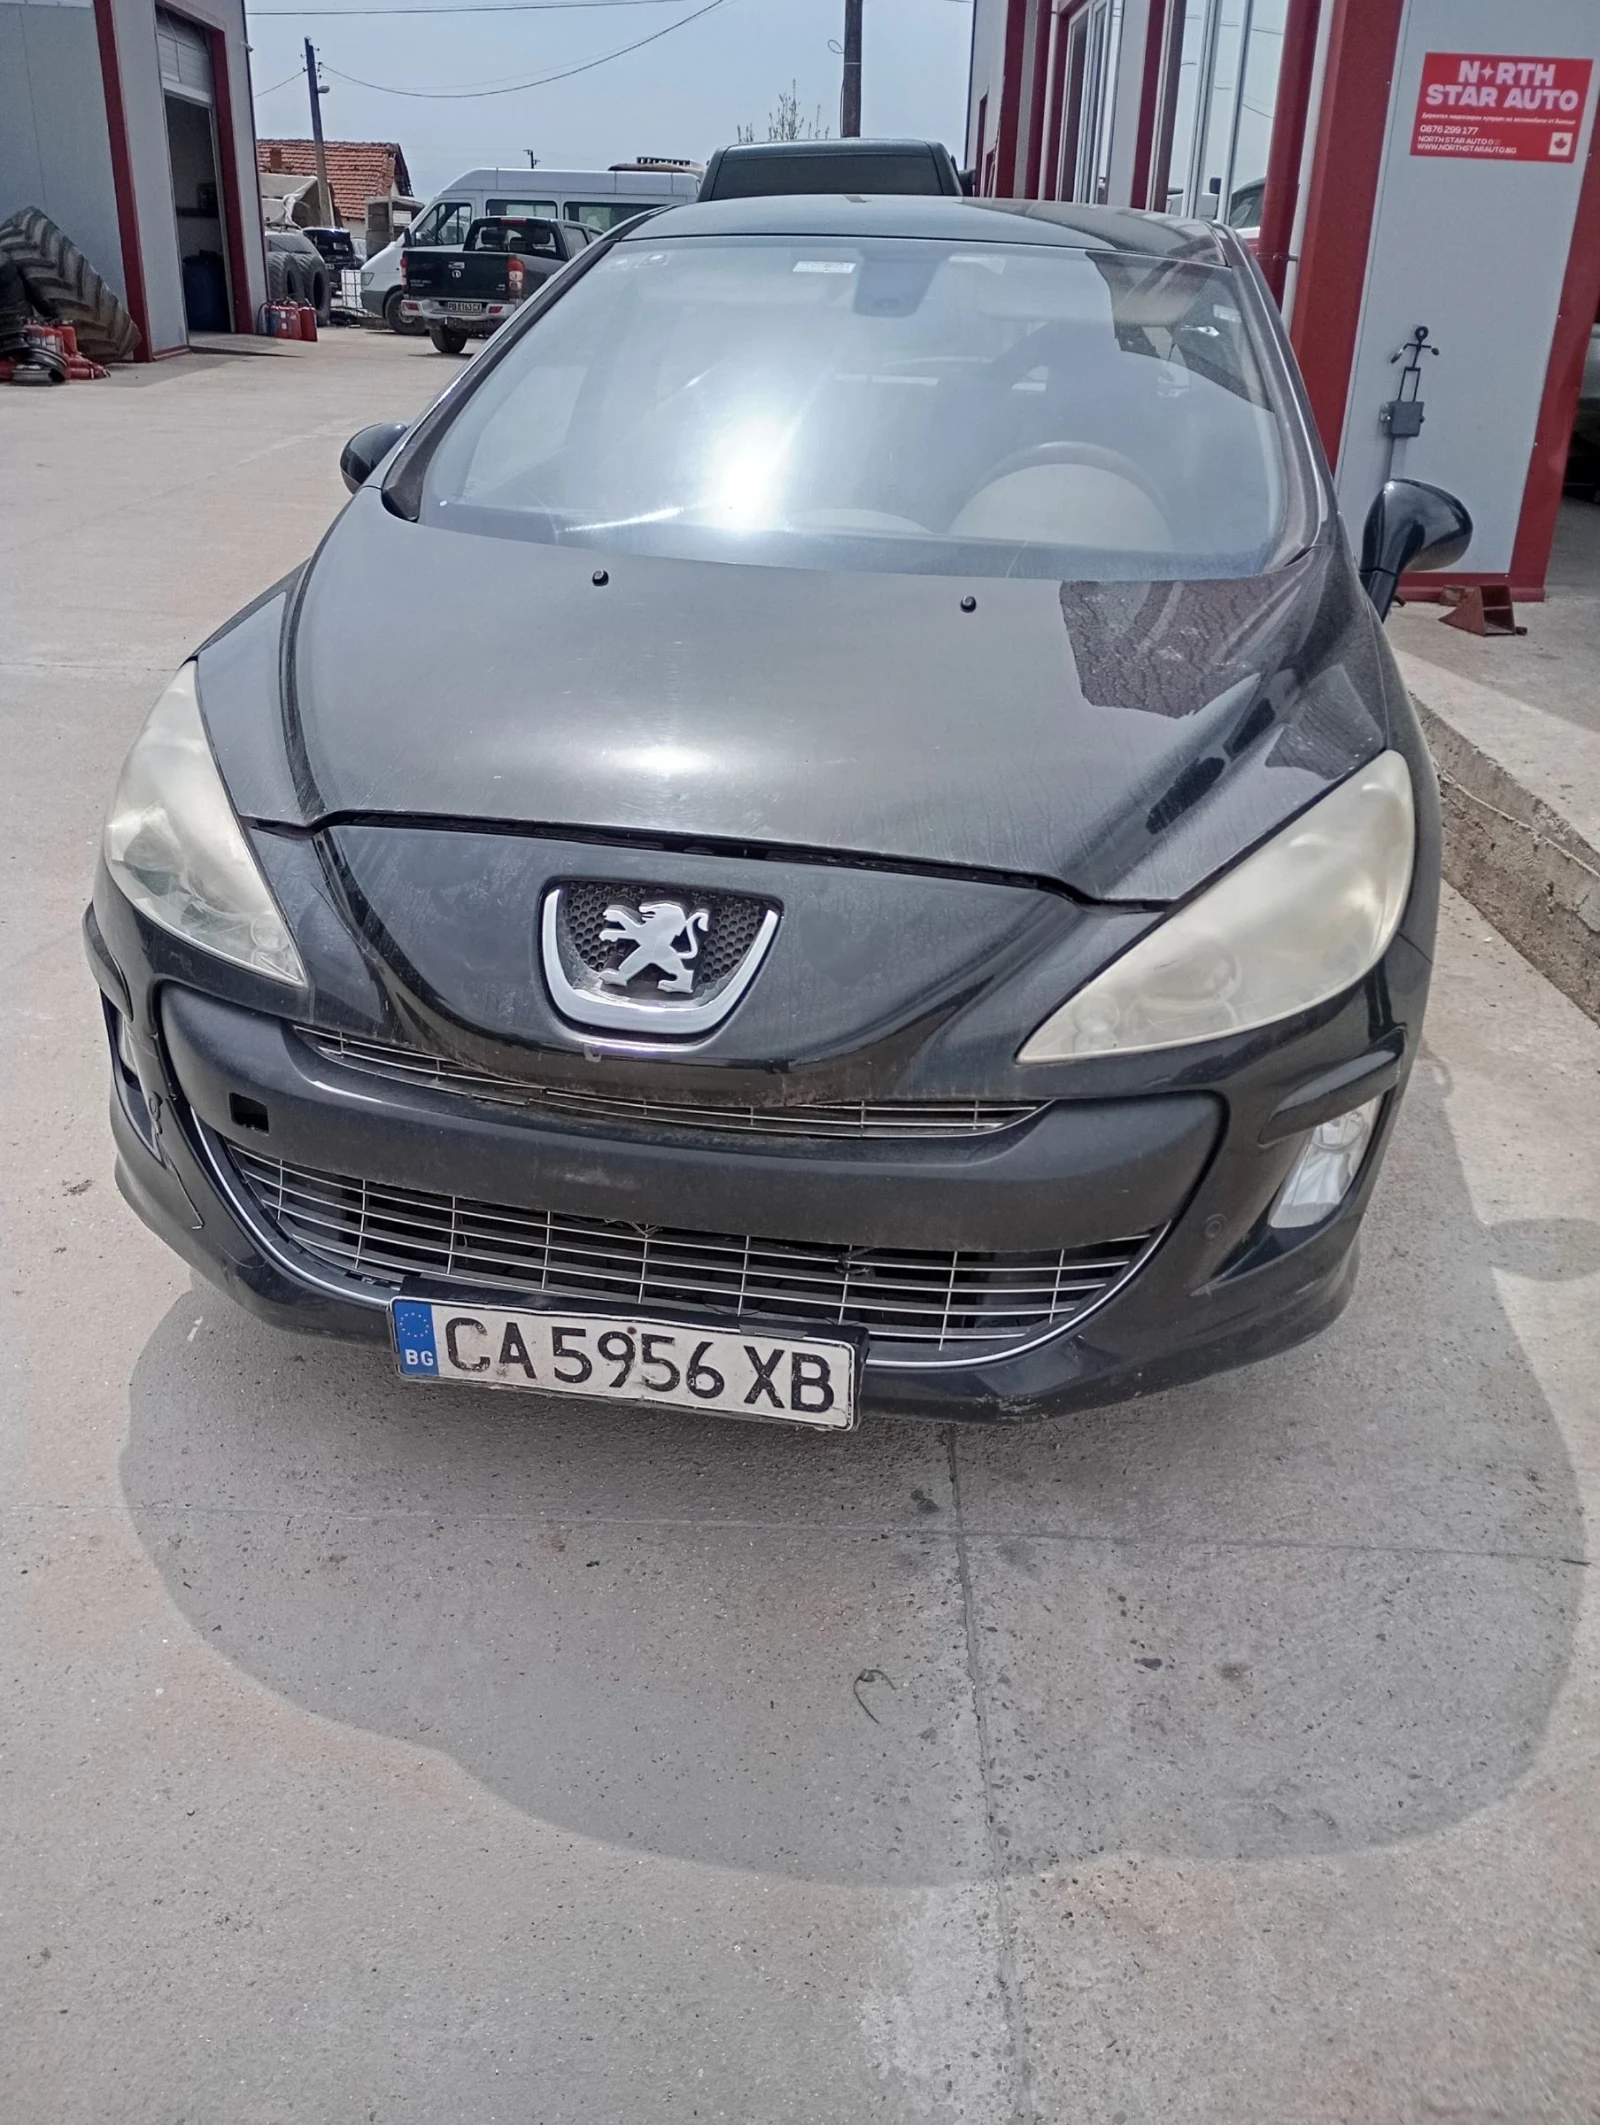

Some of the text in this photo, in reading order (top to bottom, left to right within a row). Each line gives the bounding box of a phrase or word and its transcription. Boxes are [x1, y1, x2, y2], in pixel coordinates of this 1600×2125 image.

[1425, 84, 1579, 112] STAR AUTO
[1420, 124, 1479, 136] 0876 299 177
[1445, 137, 1466, 145] STAR
[1466, 138, 1488, 146] AUTO
[405, 1348, 434, 1368] BG
[445, 1316, 836, 1414] CA 5956 XB
